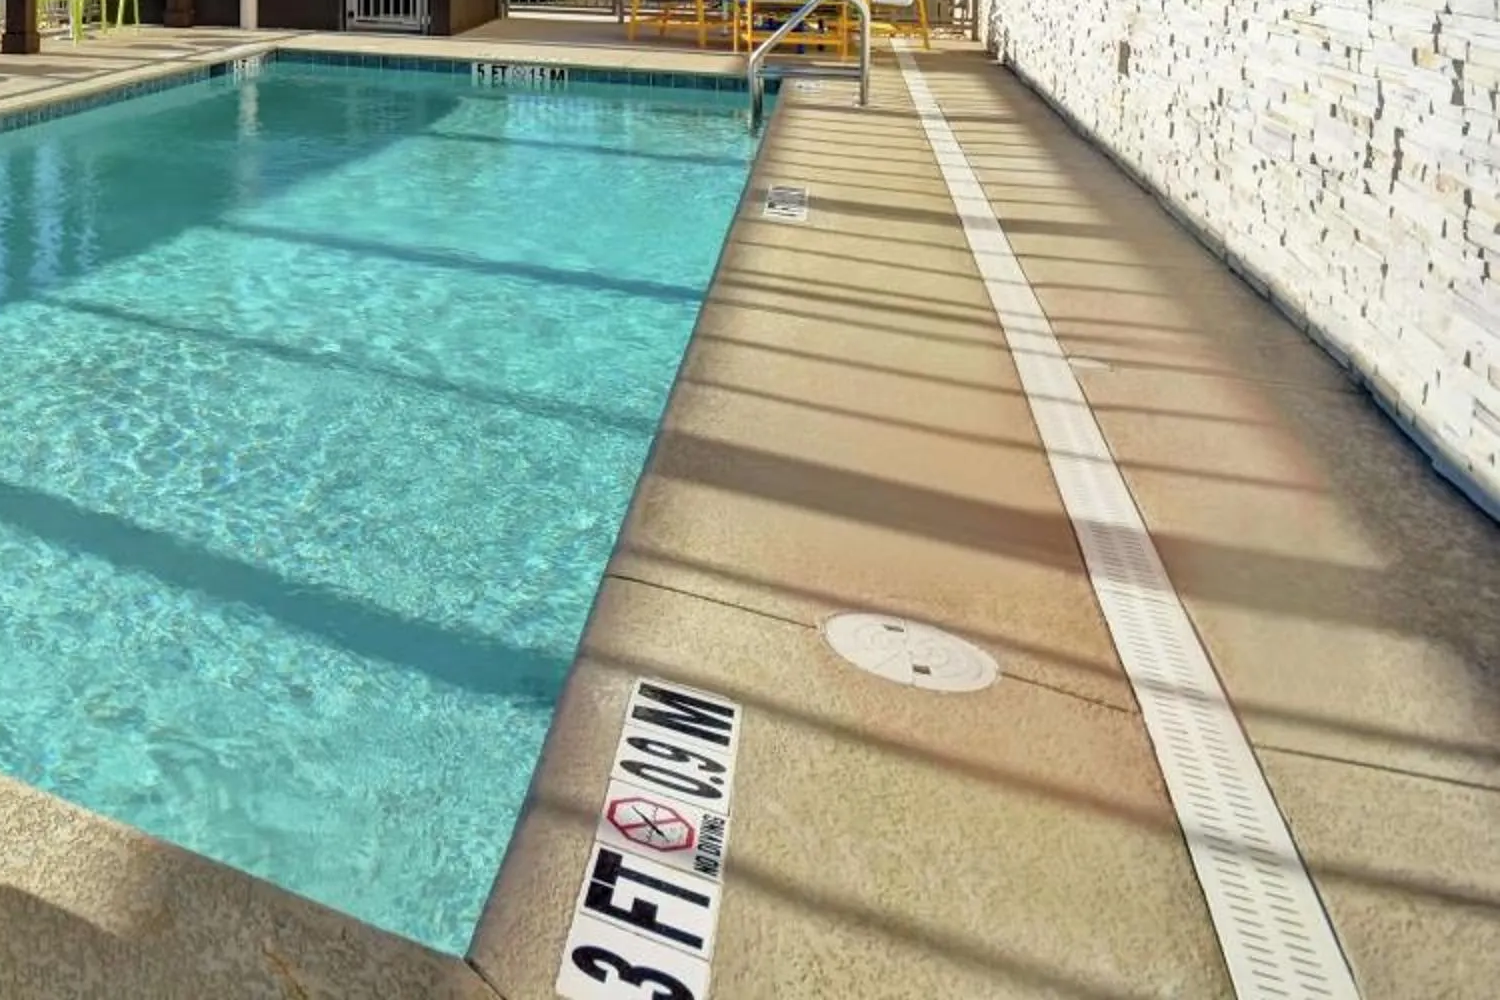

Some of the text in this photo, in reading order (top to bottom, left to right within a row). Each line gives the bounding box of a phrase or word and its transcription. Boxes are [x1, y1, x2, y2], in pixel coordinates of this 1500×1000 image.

[693, 813, 726, 877] NO DIVING
[584, 848, 711, 950] FT
